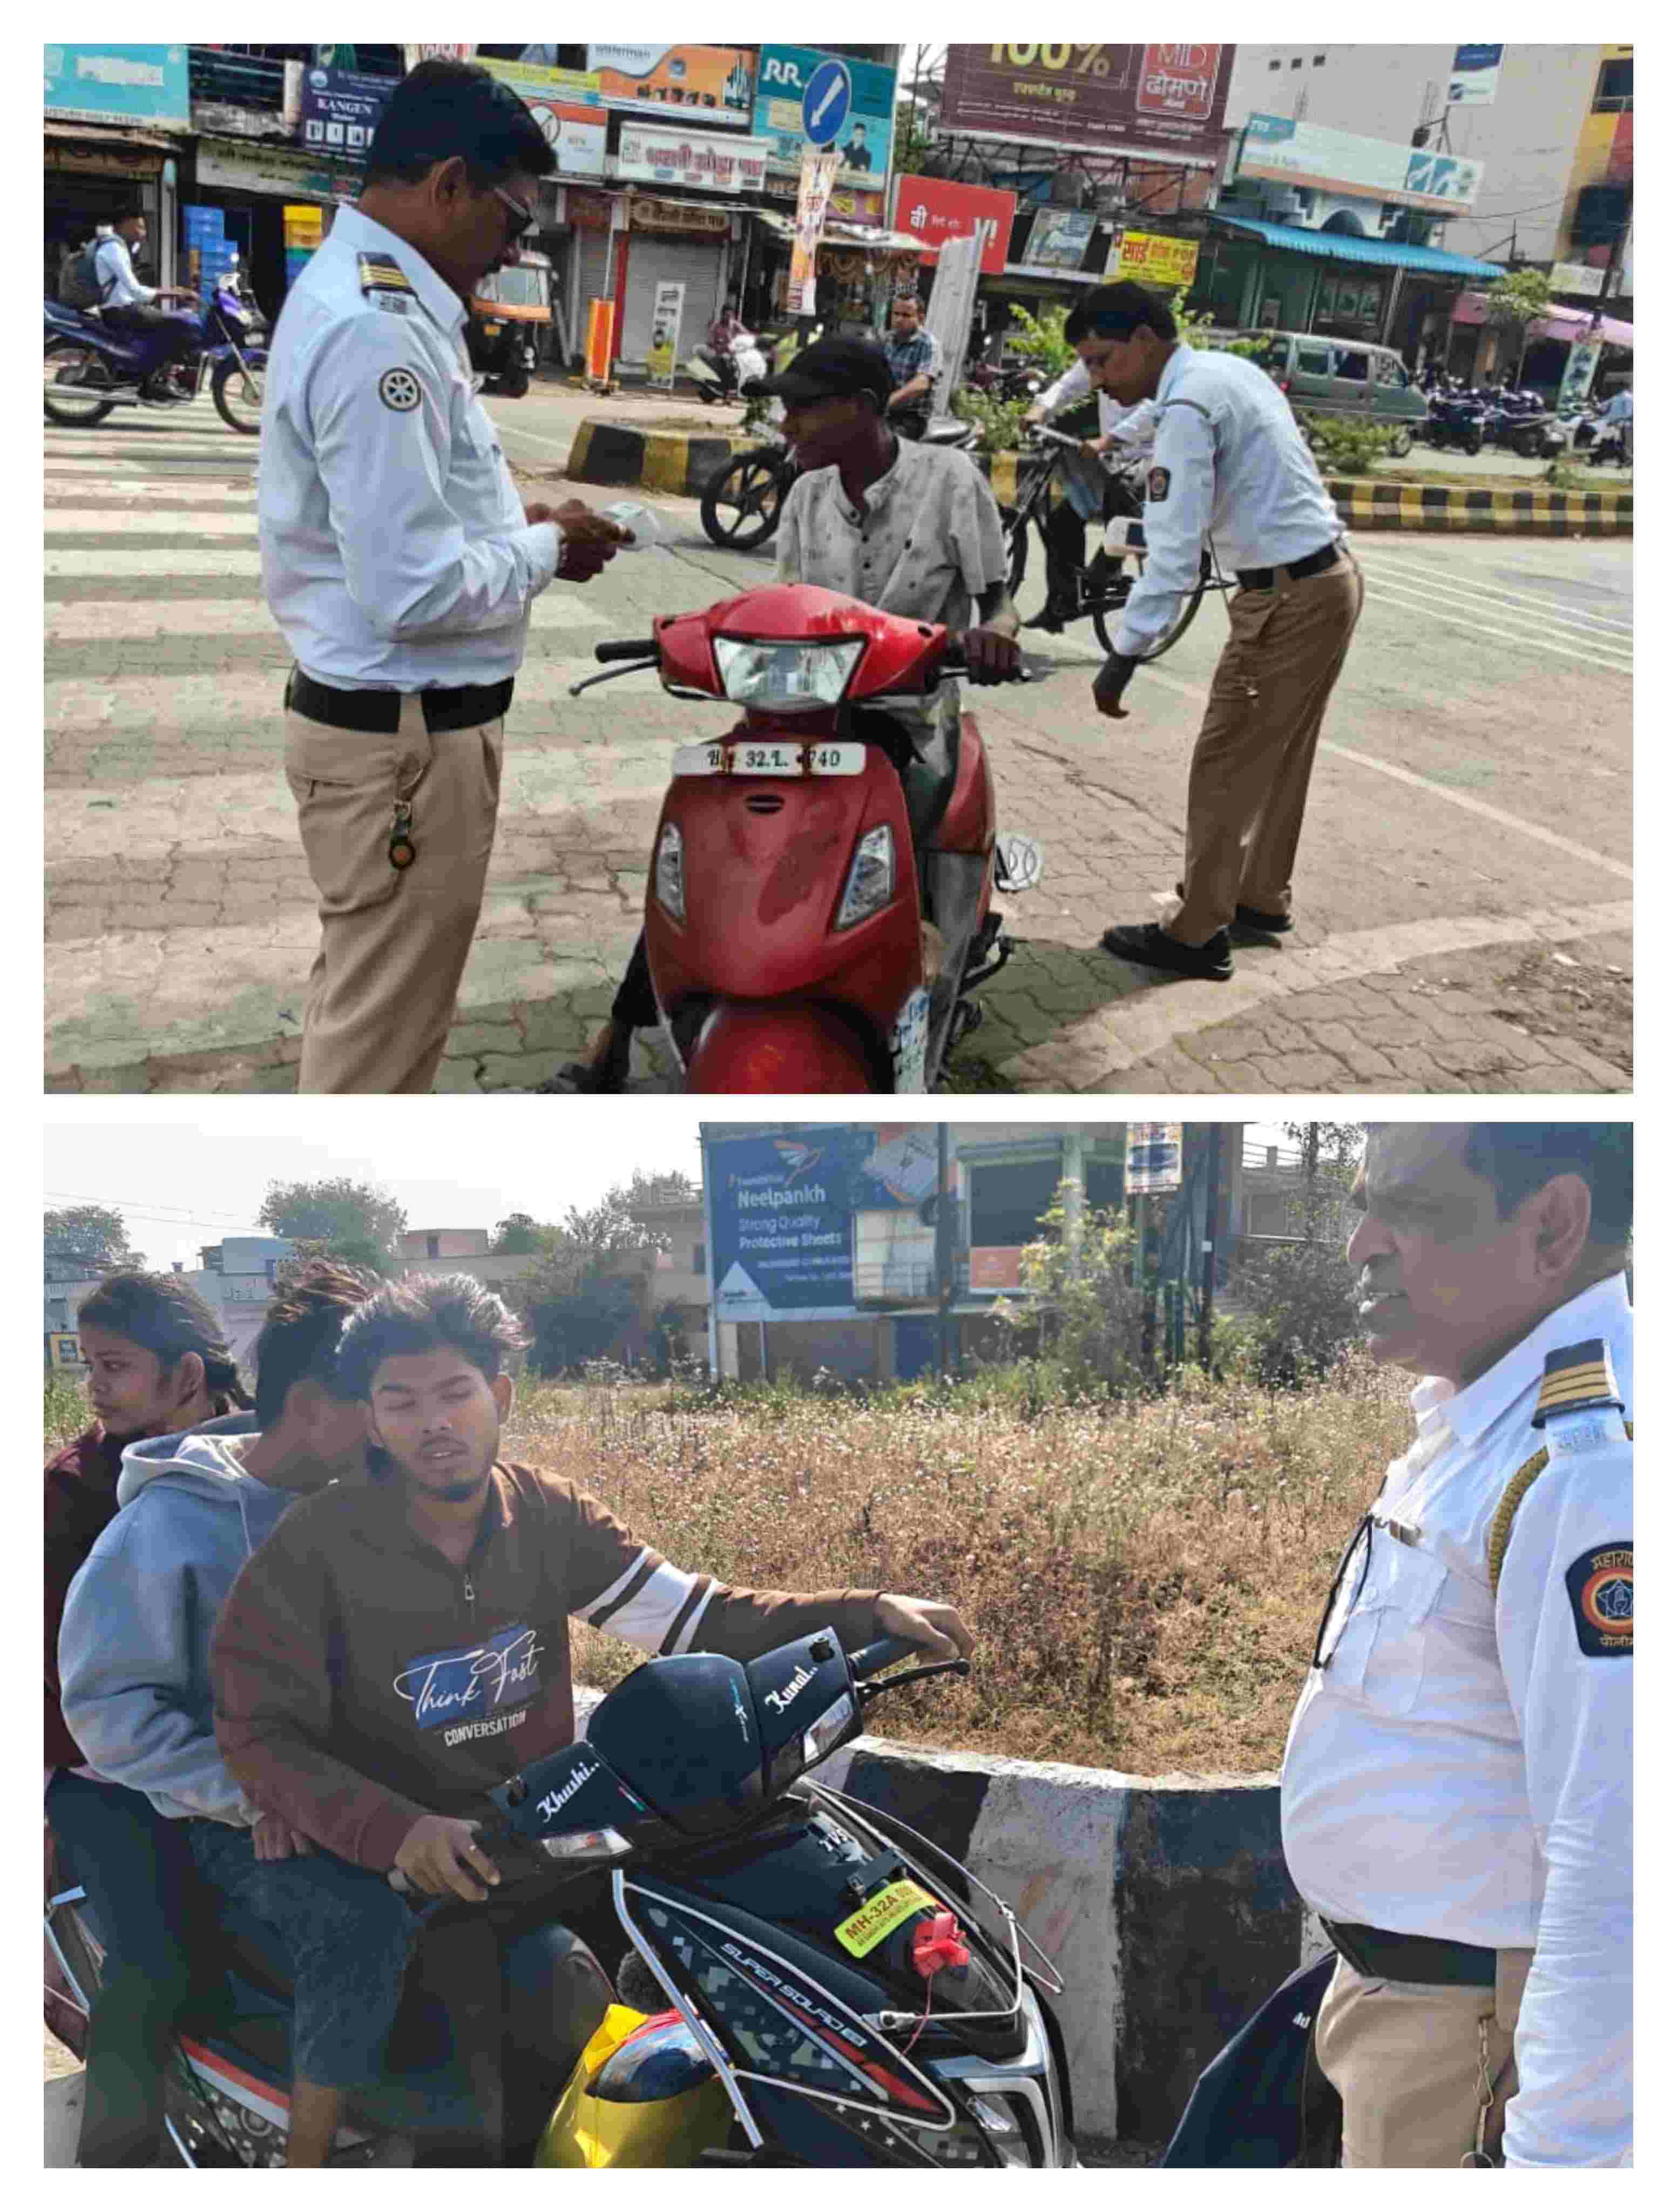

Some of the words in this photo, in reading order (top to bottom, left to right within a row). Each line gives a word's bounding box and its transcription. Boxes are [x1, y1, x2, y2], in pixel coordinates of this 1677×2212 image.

[317, 97, 373, 115] KANGEN
[738, 1184, 826, 1210] Neelpankh
[738, 1217, 776, 1234] Strong
[779, 1215, 821, 1232] Quality
[739, 1235, 799, 1249] Protective
[801, 1232, 842, 1246] Sheets
[393, 1649, 485, 1721] Think
[444, 1710, 526, 1748] CONVERSATION
